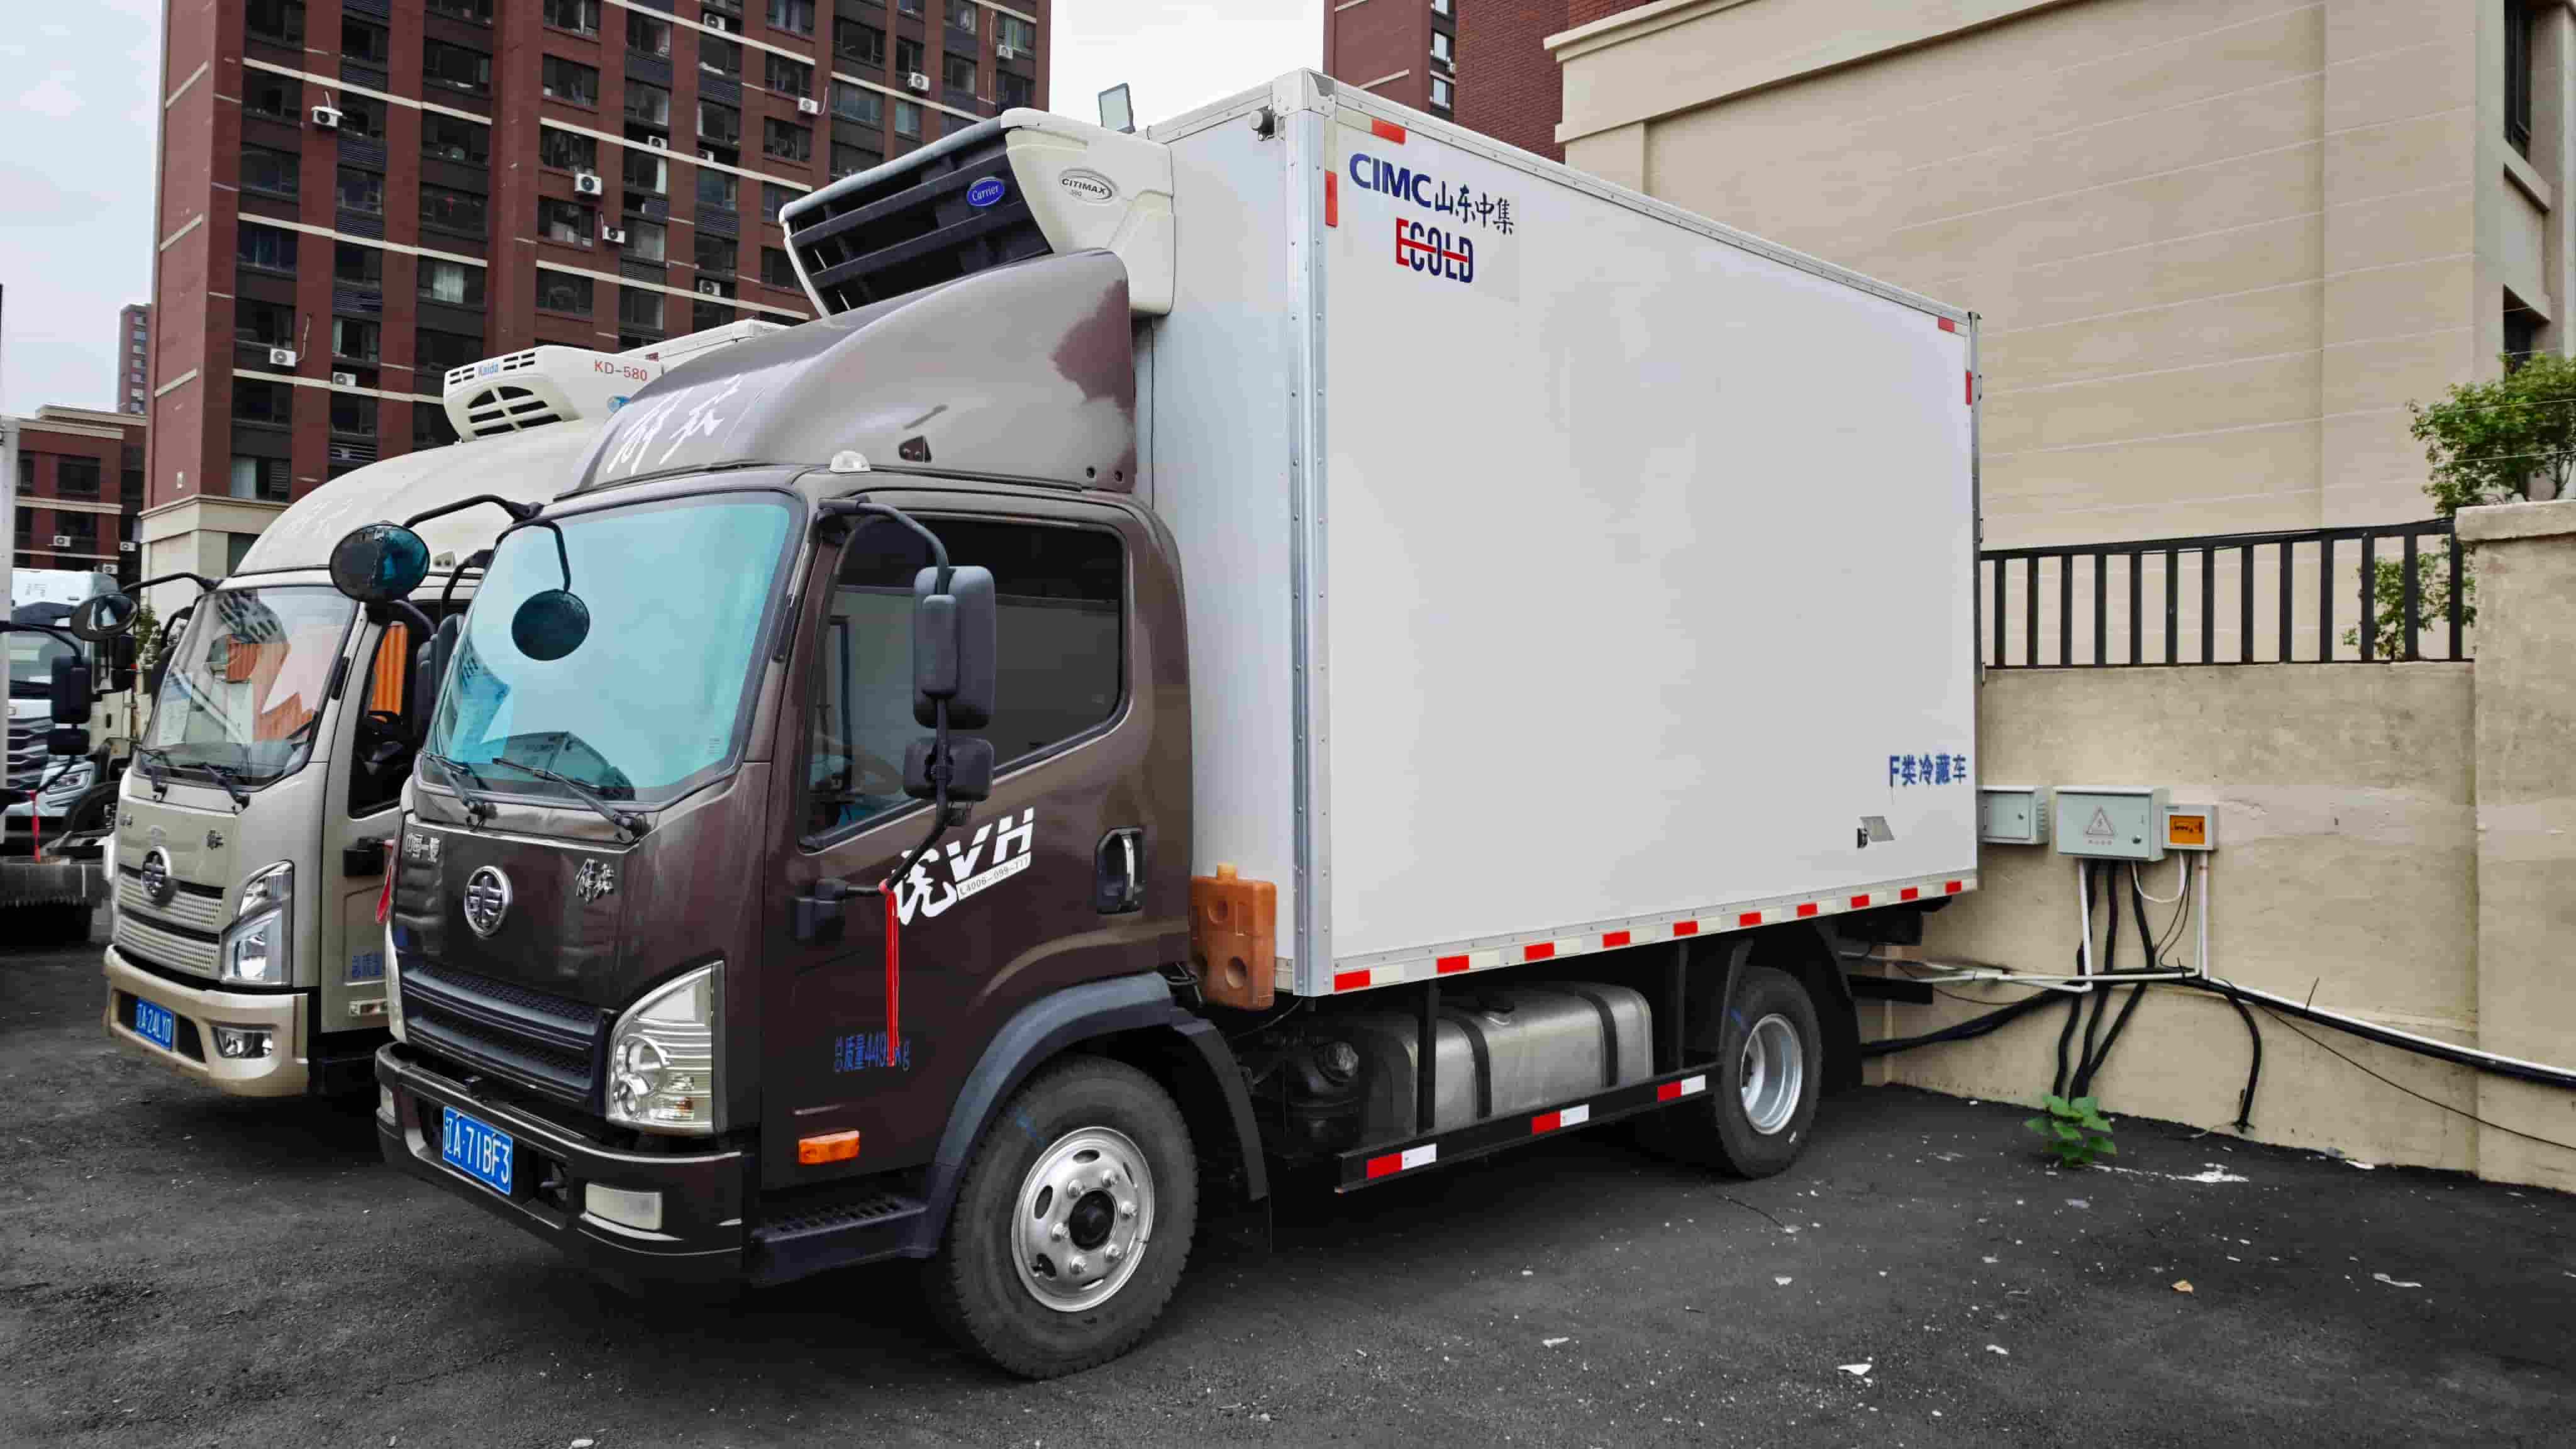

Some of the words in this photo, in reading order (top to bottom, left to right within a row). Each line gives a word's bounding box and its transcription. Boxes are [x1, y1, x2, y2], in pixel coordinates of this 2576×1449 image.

[972, 184, 999, 201] Carrier
[1062, 178, 1106, 196] CITIMAX
[1349, 153, 1432, 209] CIMC
[1435, 180, 1514, 236] 山东中集
[1396, 217, 1474, 284] ECOLD
[594, 360, 648, 382] KD-580
[1889, 752, 1967, 787] F类冷藏车
